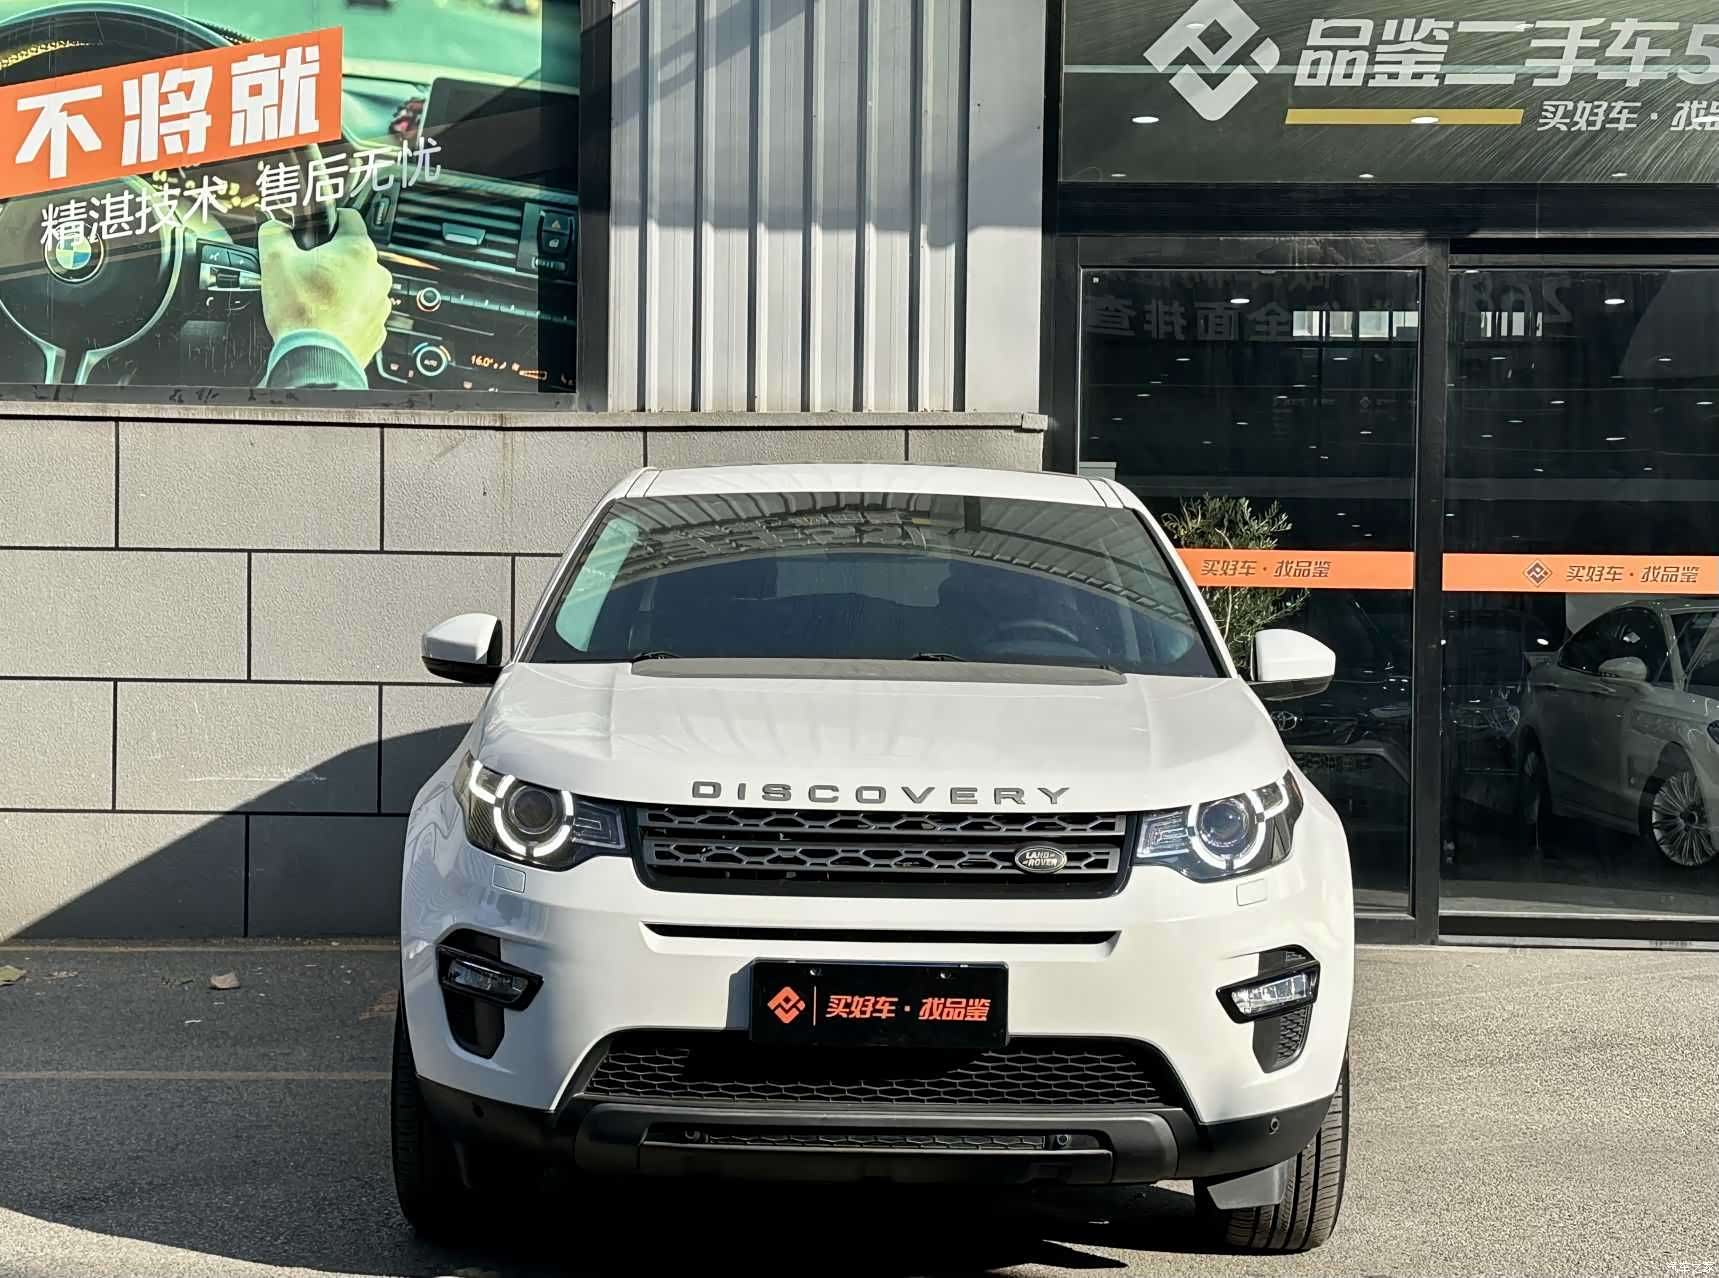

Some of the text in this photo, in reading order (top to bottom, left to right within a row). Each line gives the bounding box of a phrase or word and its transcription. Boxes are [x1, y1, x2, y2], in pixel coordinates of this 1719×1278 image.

[15, 44, 320, 180] 不将就
[40, 136, 442, 251] 精湛技术 售后无忧
[692, 781, 1069, 805] DISCOVERY
